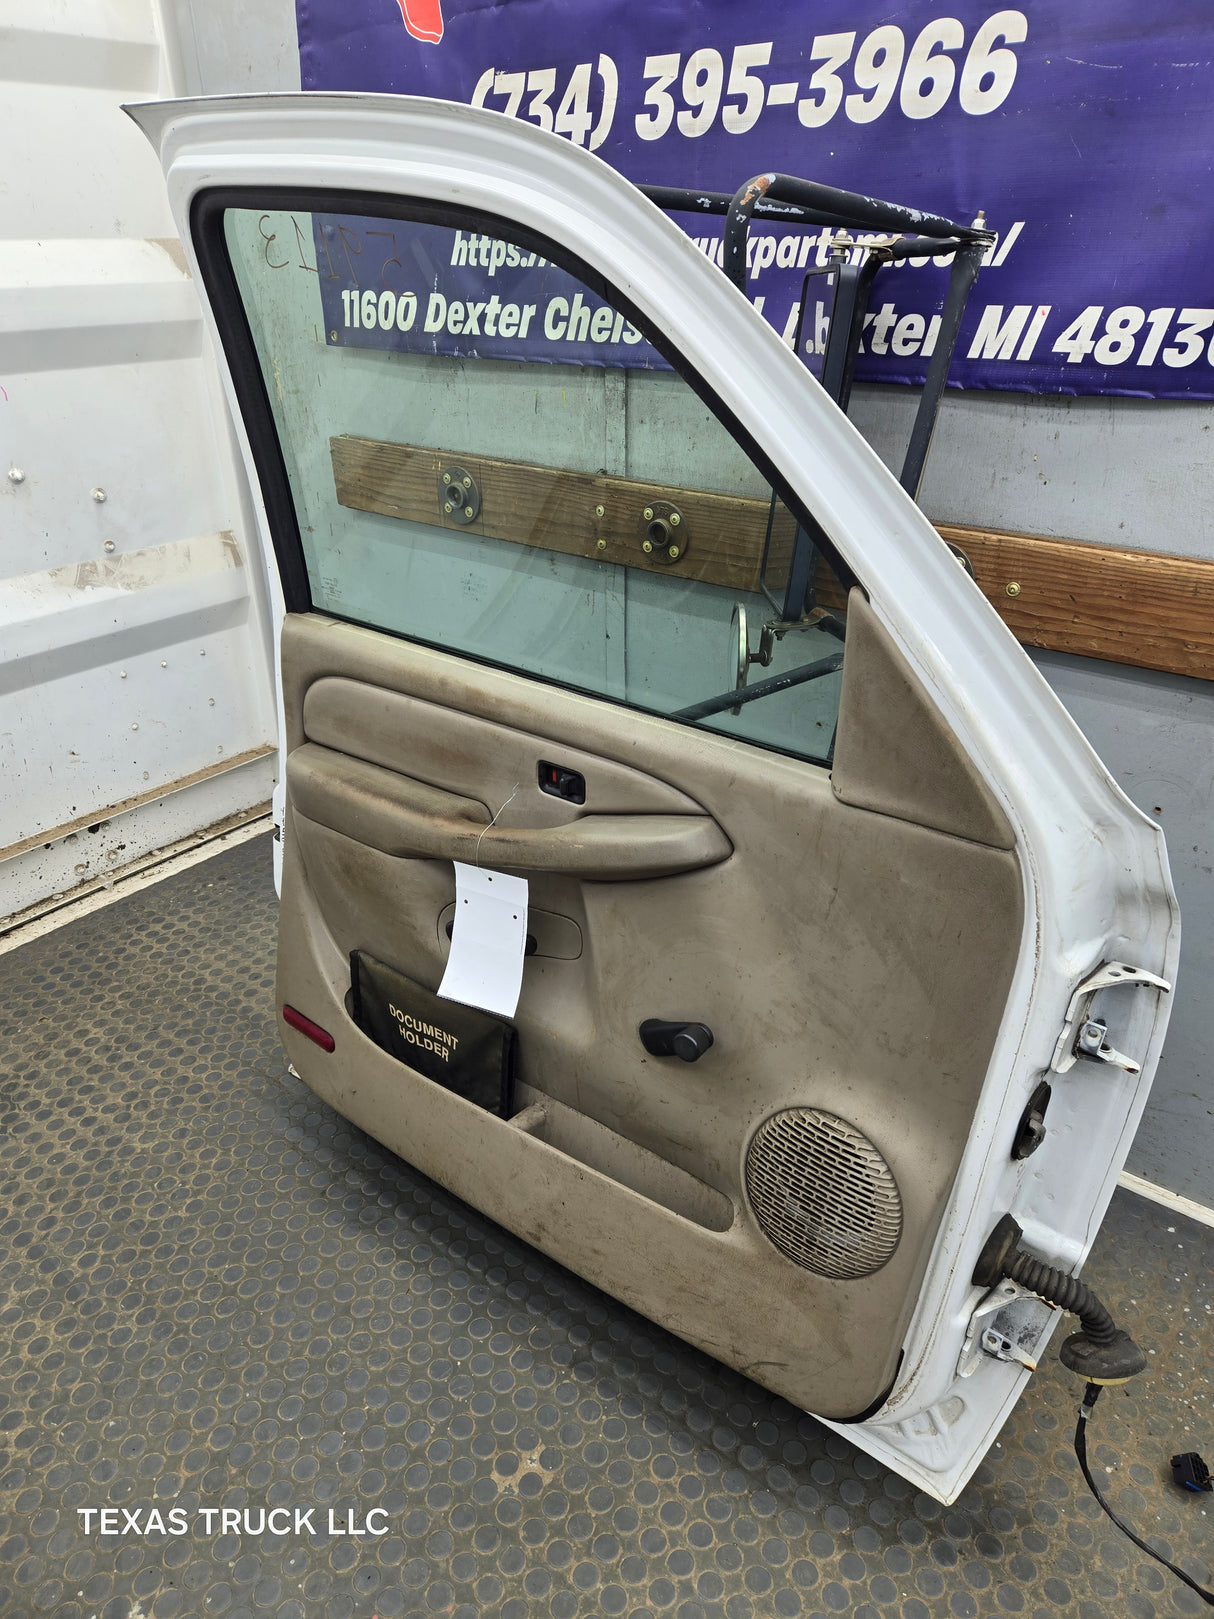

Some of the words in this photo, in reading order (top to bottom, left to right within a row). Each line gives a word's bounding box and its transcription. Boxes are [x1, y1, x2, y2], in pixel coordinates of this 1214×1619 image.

[635, 9, 1028, 141] 395-3966
[341, 289, 418, 332] 11600
[424, 292, 537, 339] Dexter
[966, 304, 1053, 361] MI
[1051, 305, 1214, 368] 4813
[388, 1003, 459, 1050] DOCUMENT
[398, 1024, 449, 1063] HOLDER
